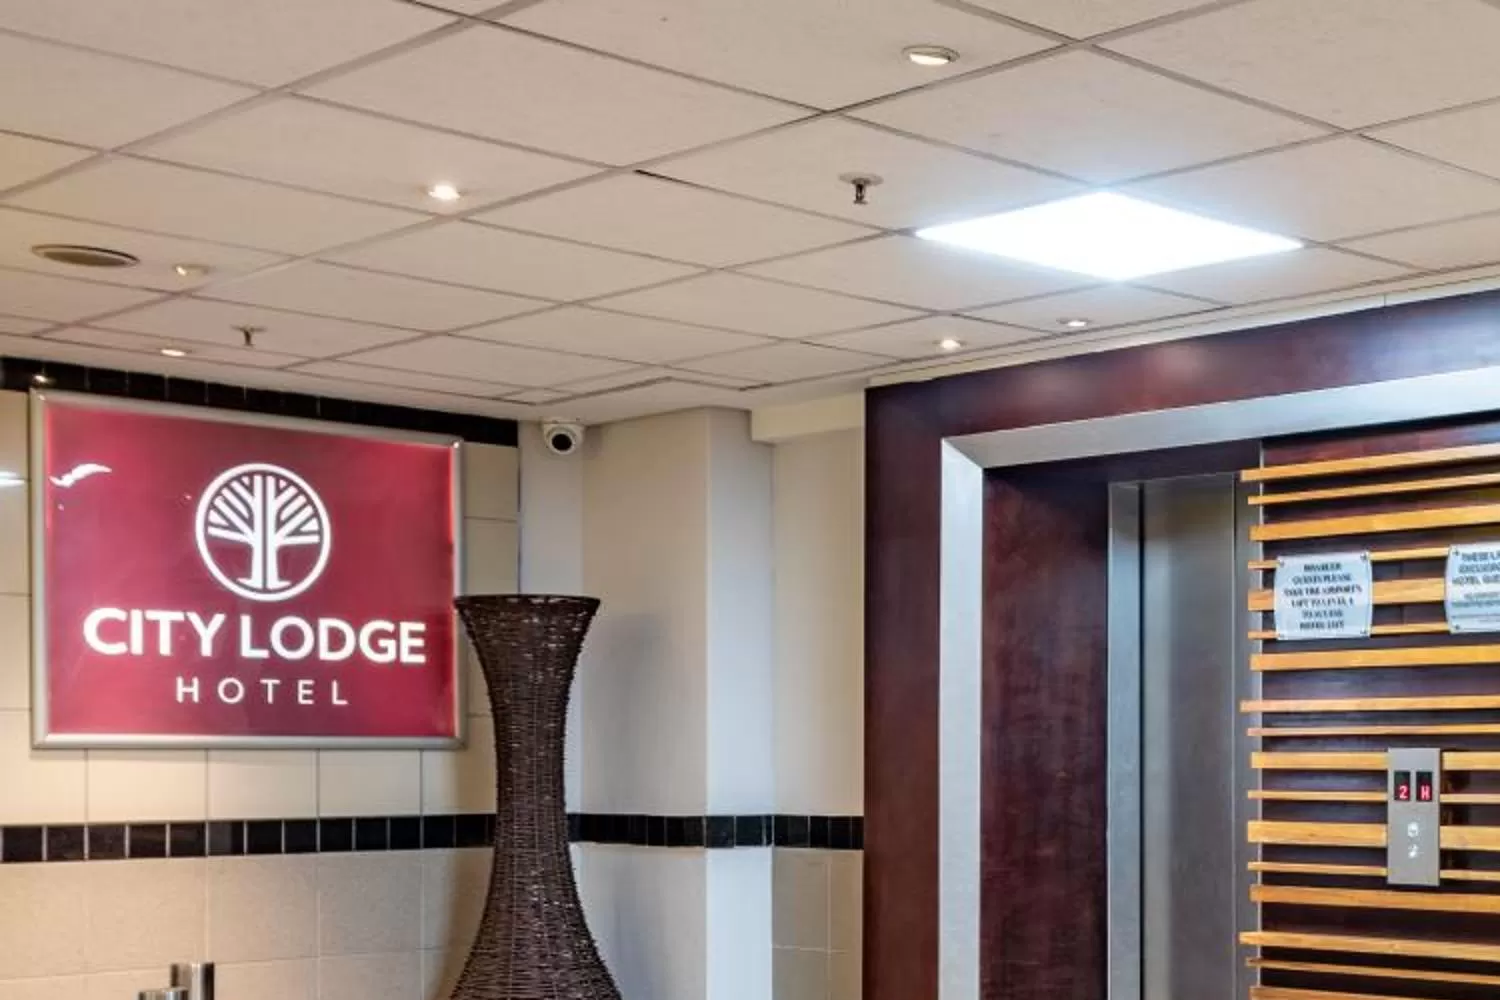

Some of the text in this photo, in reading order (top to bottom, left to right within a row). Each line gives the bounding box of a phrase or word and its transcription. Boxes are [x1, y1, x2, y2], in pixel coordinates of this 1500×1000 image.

[83, 607, 426, 664] CITY LODGE
[176, 677, 348, 705] HOTEL
[1399, 785, 1408, 799] 2
